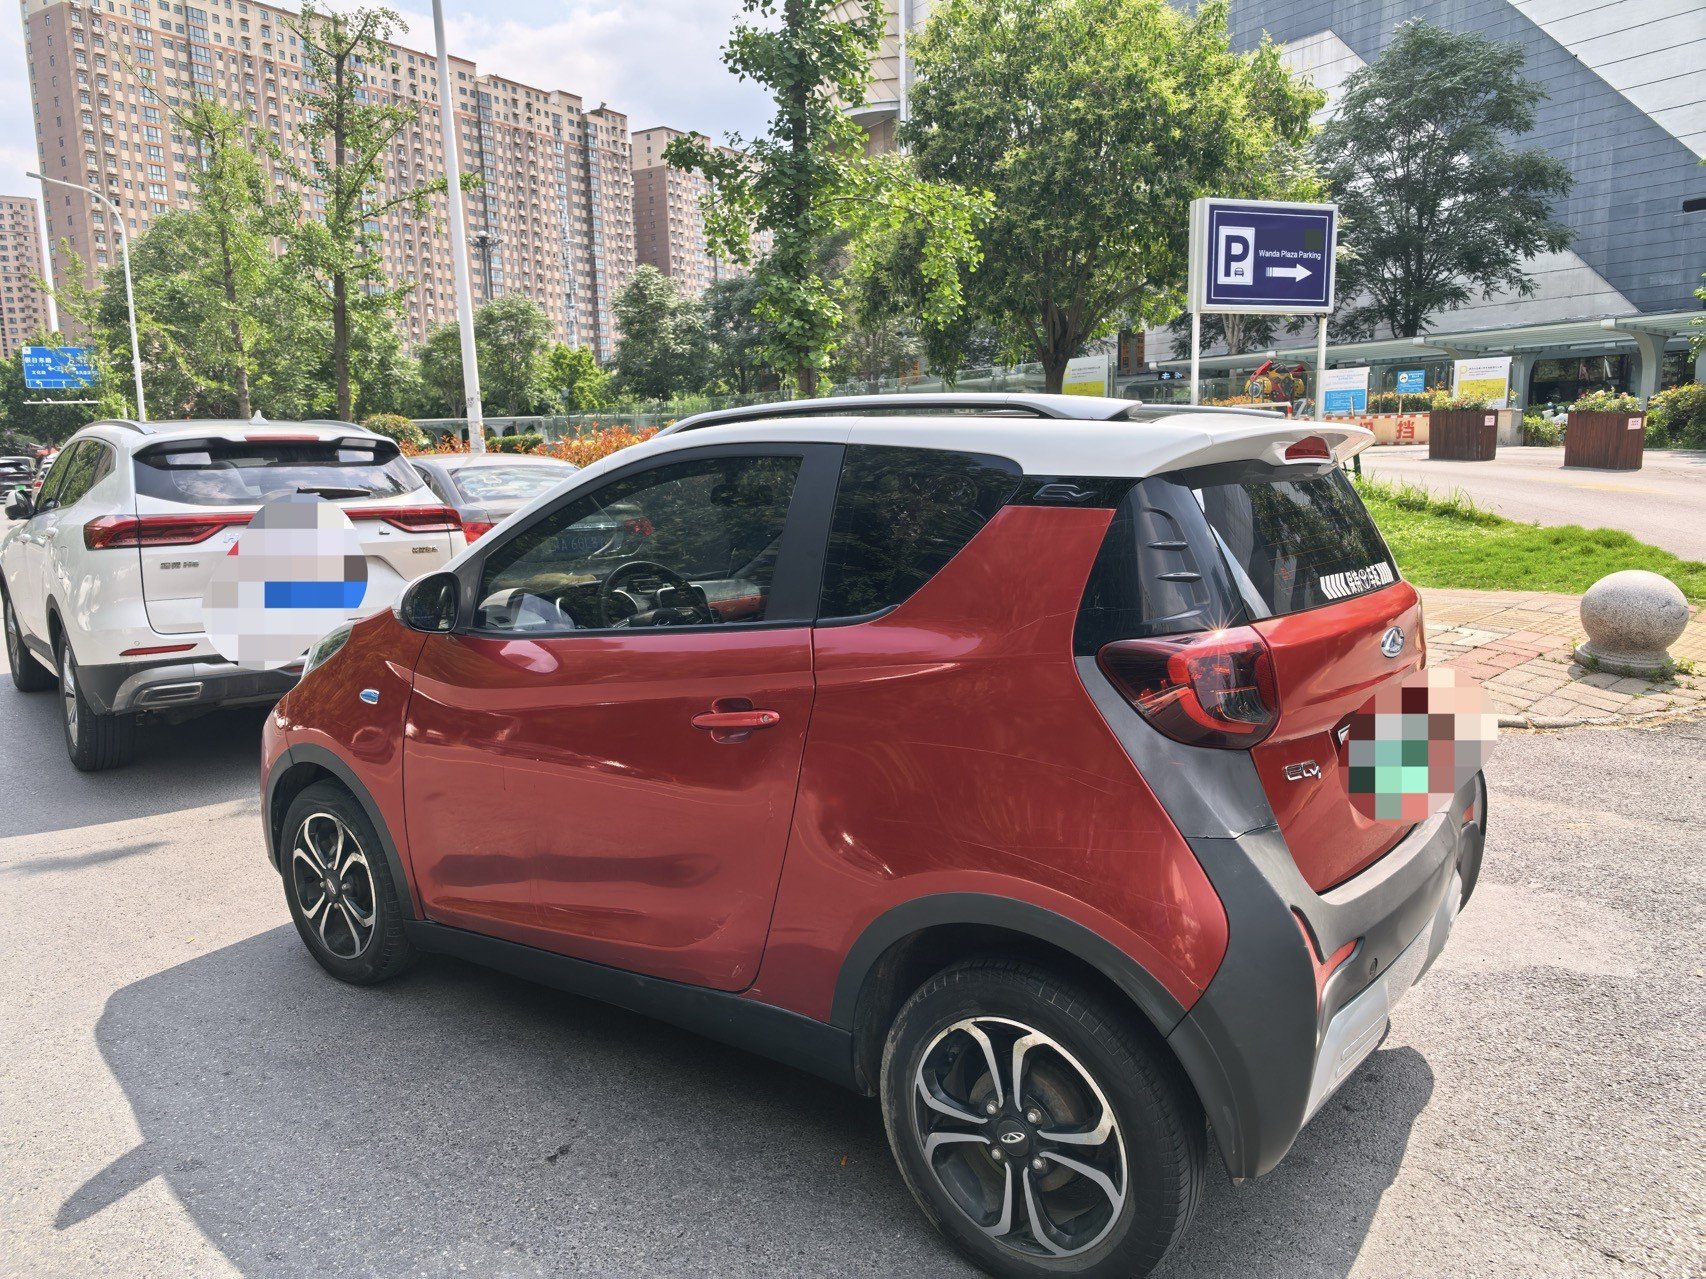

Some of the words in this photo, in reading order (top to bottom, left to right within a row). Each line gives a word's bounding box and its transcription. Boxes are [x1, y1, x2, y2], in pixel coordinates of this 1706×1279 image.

[1259, 249, 1280, 258] Wanda
[1281, 250, 1297, 259] Plaza
[1298, 251, 1321, 261] Parking
